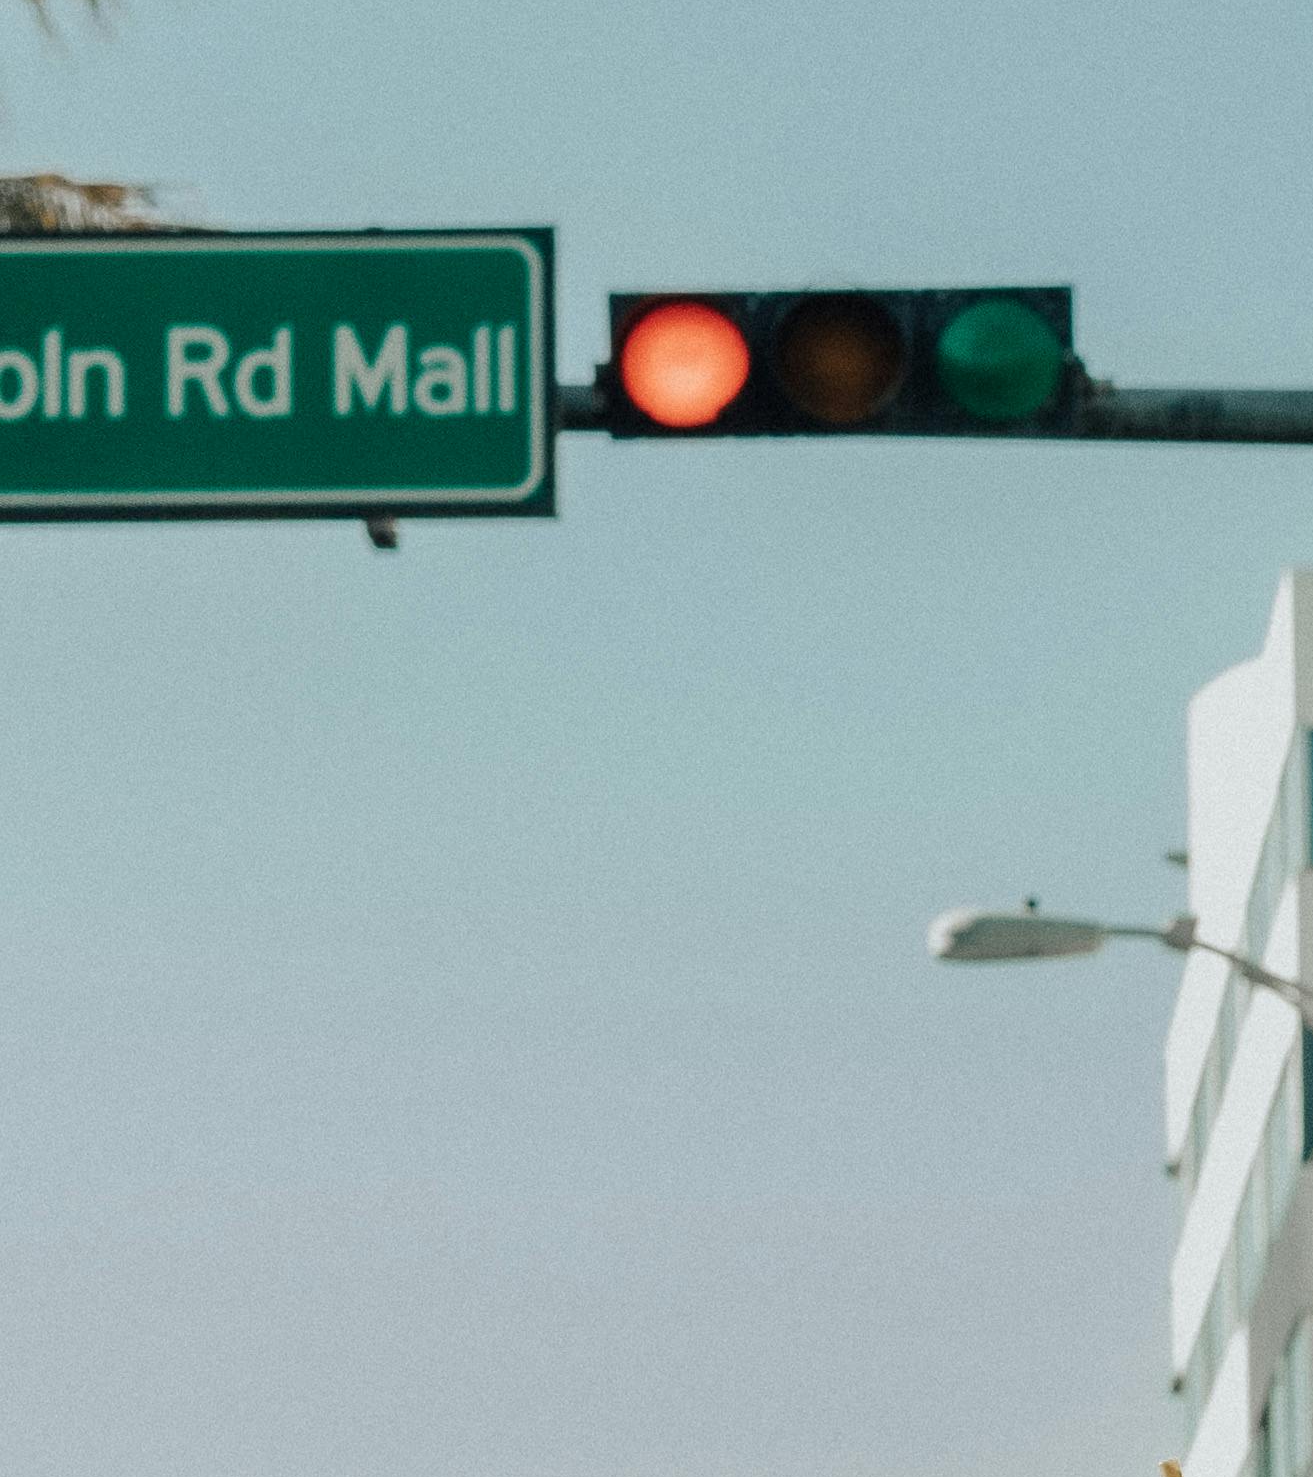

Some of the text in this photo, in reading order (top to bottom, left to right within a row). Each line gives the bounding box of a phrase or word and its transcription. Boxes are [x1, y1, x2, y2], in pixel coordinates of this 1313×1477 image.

[0, 324, 516, 419] oln Rd Mall
